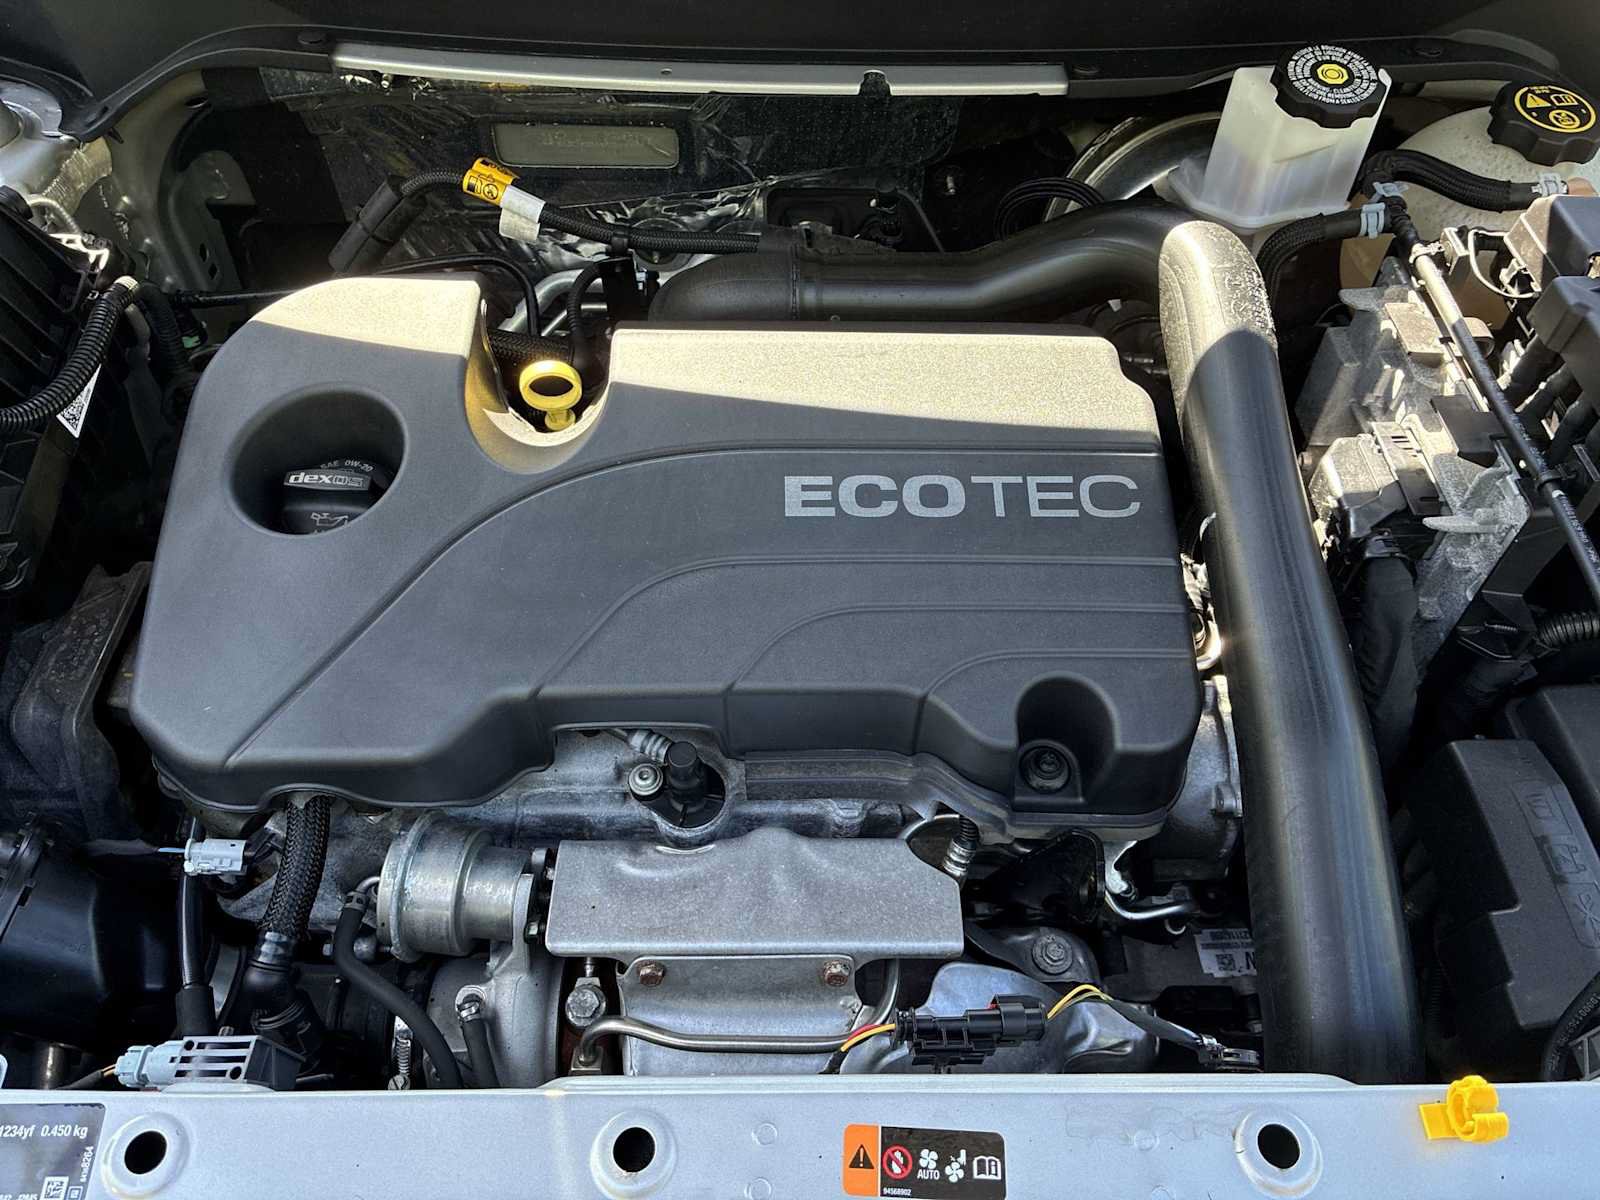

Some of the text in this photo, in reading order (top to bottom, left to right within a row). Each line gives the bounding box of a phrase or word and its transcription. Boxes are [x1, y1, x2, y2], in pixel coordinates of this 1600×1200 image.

[288, 472, 364, 487] dexos
[784, 475, 1141, 518] ECOTEC
[40, 1124, 72, 1137] 0.450
[73, 1124, 88, 1140] kg
[917, 1169, 940, 1180] AUTO
